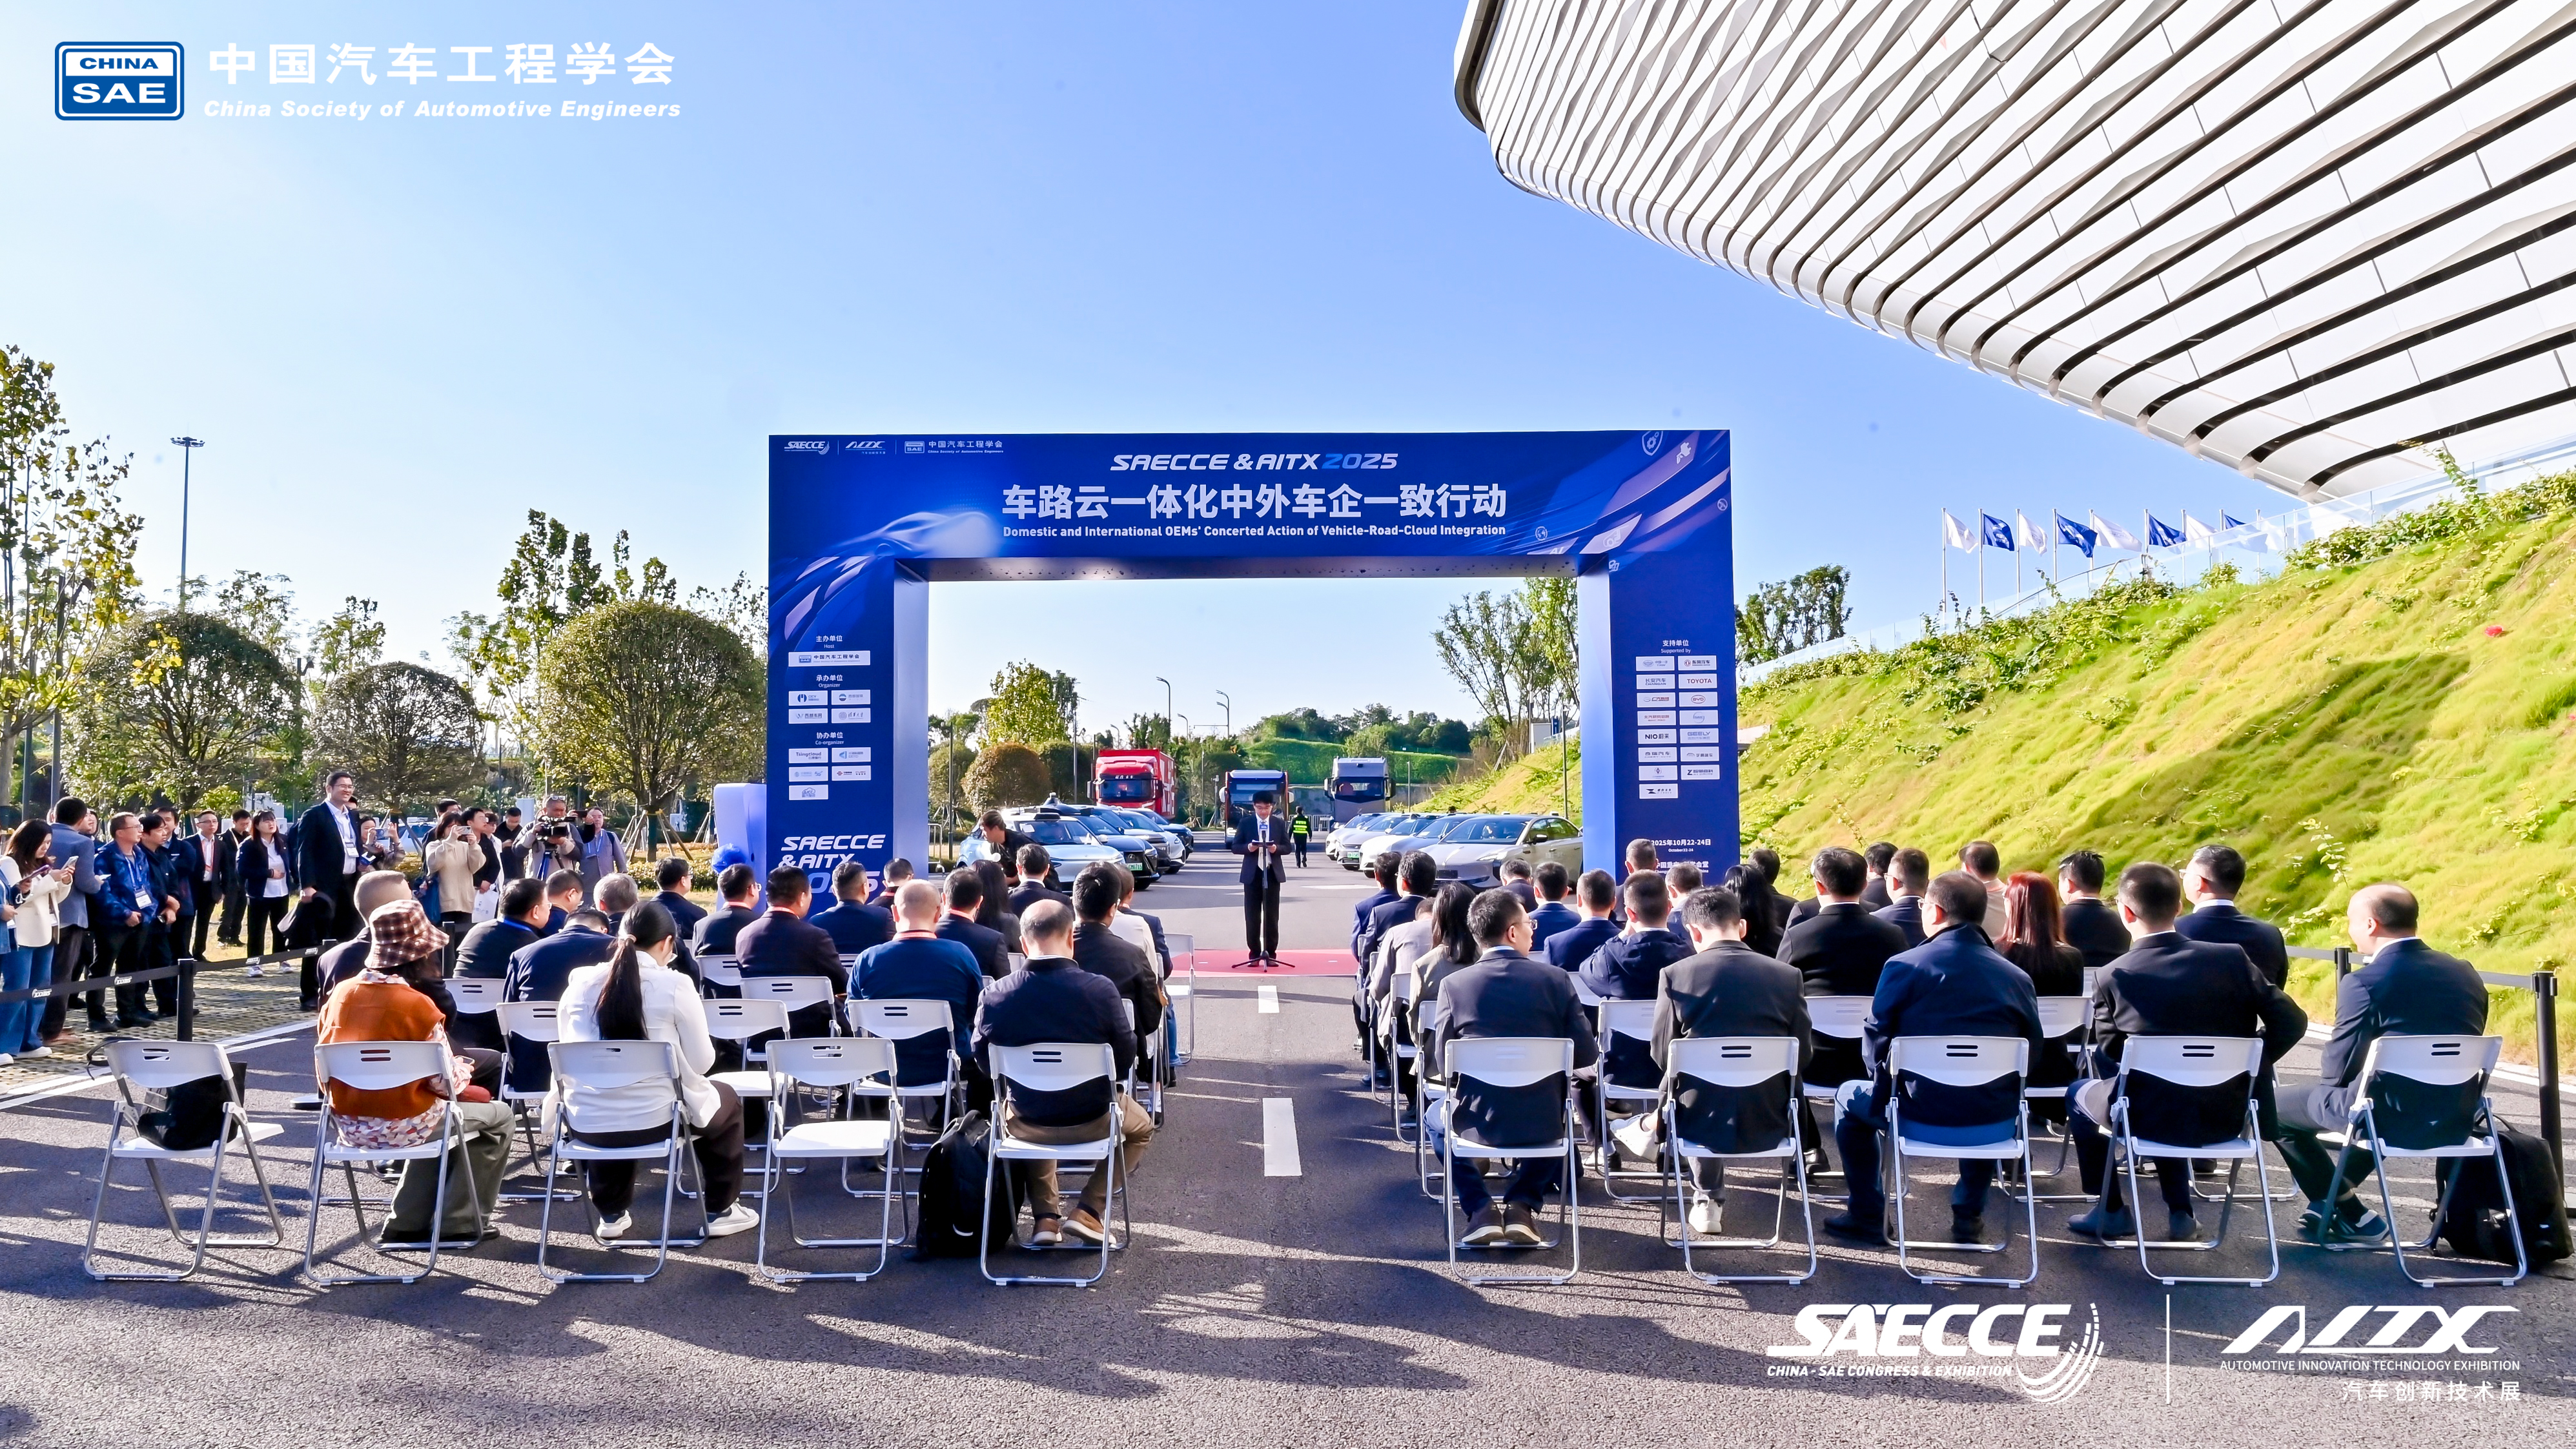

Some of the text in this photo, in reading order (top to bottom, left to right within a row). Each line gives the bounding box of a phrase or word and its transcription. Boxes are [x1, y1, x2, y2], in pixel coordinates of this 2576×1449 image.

[1110, 455, 1230, 471] SAECCE
[1322, 453, 1398, 469] 2025
[1002, 484, 1507, 519] 车路云一体化中外车企一致行动
[1003, 524, 1506, 537] Domestic and International OEMs' Concerted Action of Vehicle-Road-Cloud Integration
[781, 834, 886, 851] SAECCE
[798, 854, 855, 868] AITX
